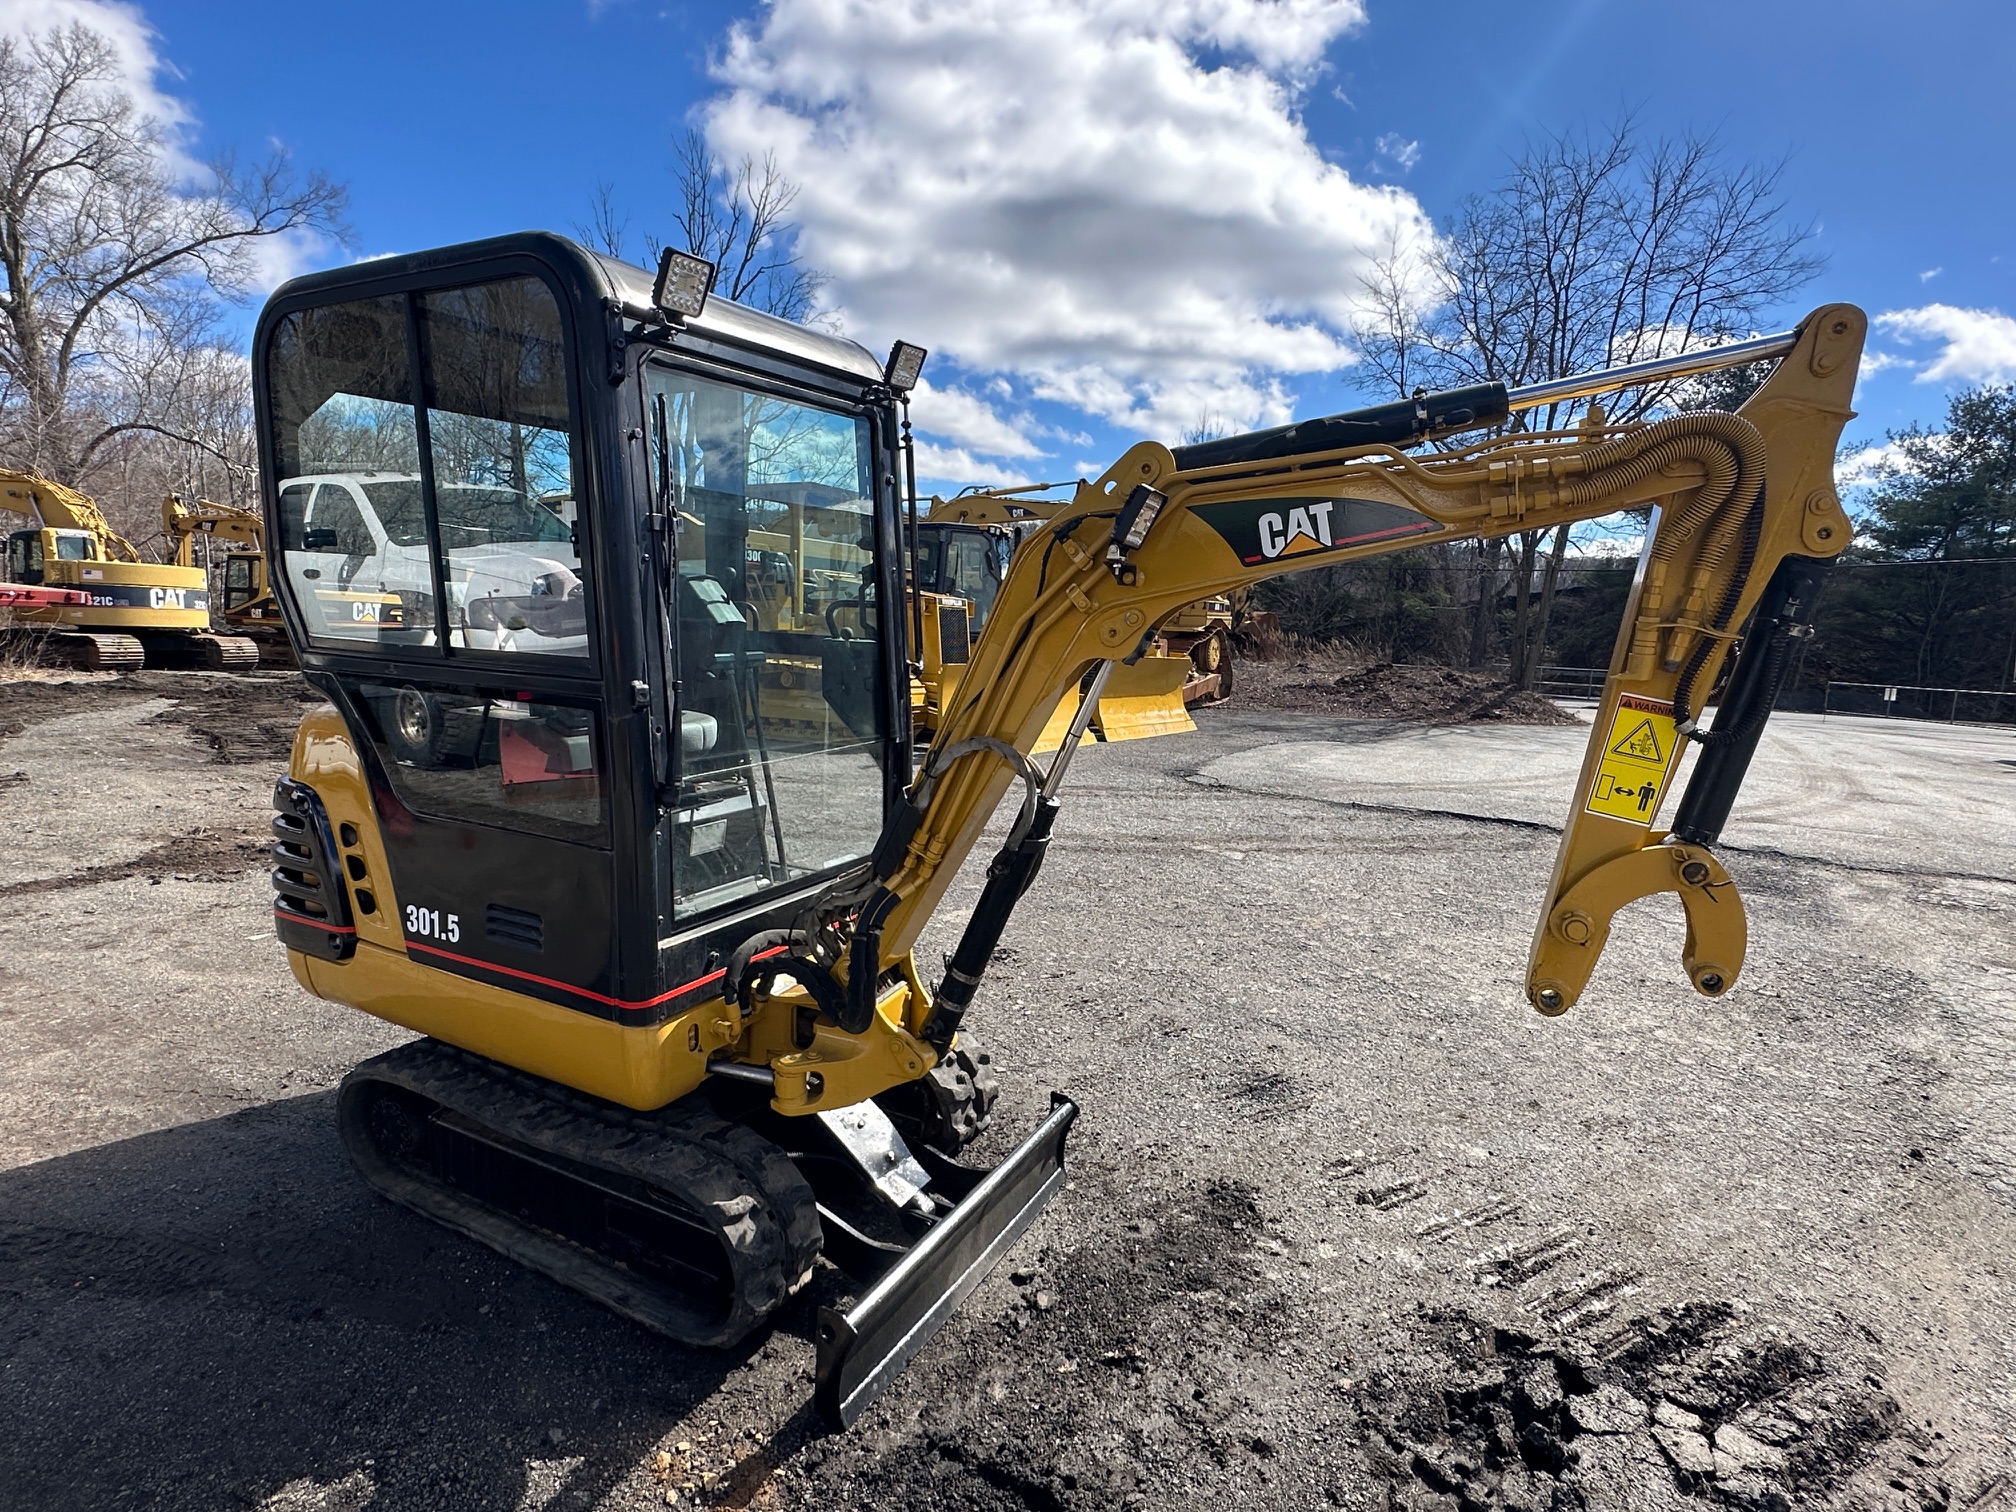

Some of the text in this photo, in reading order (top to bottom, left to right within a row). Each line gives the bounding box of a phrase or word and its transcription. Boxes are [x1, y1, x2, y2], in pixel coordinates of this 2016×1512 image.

[1012, 508, 1024, 518] CAT
[1258, 501, 1333, 558] CAT
[150, 588, 187, 610] CAT
[251, 608, 263, 619] CAT
[352, 601, 382, 622] CAT
[1634, 700, 1675, 717] WARNIN
[406, 904, 460, 943] 301.5
